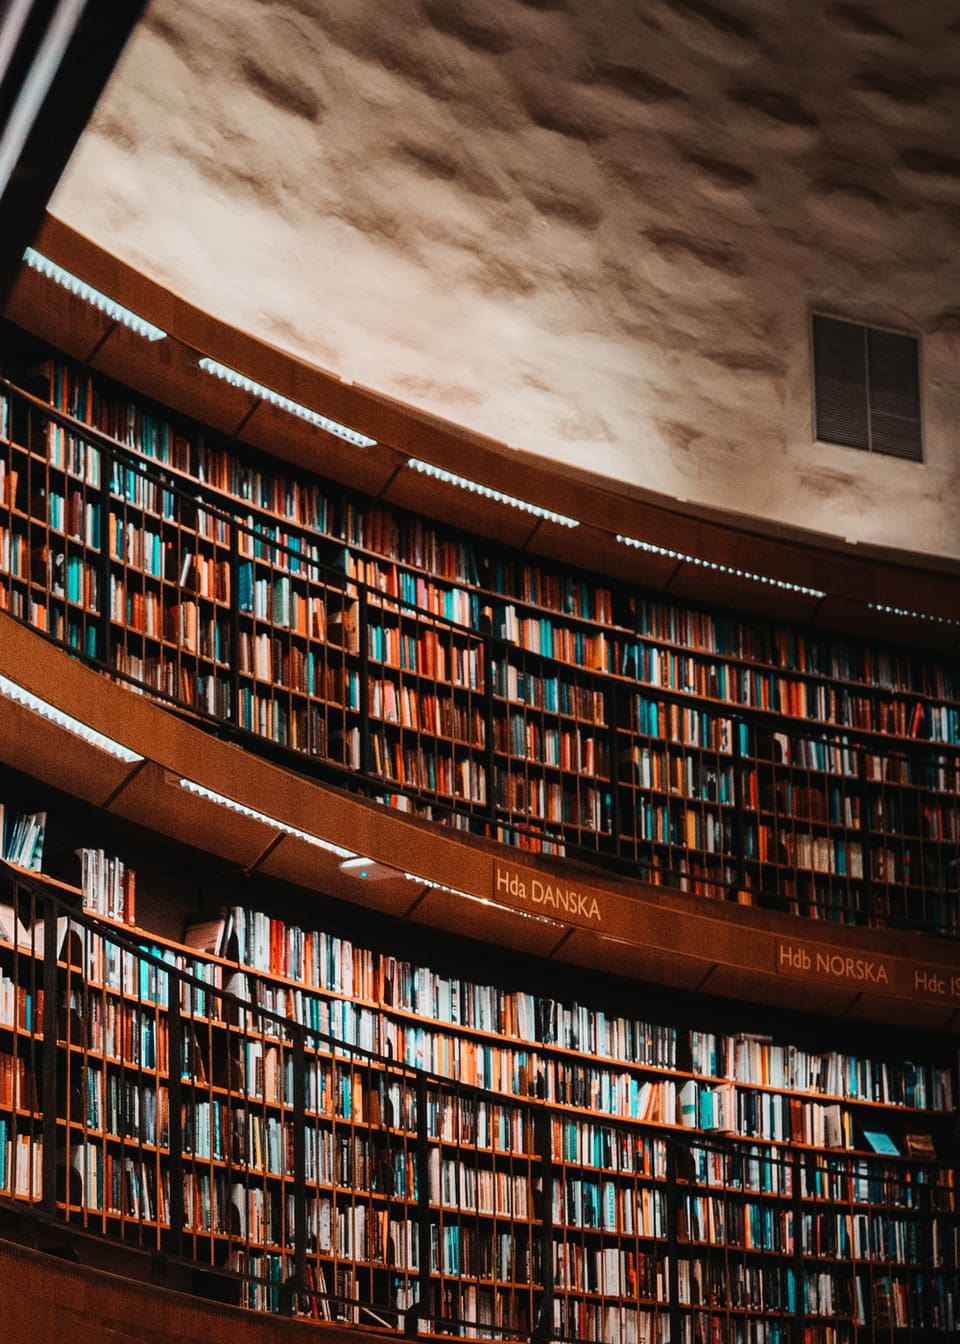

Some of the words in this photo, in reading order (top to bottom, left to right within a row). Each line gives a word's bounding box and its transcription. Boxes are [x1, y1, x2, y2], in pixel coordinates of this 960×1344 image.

[497, 868, 526, 898] Hda
[531, 879, 602, 921] DANSKA
[779, 944, 811, 970] Hdb
[816, 952, 889, 984] NORSKA
[914, 970, 945, 994] Hdc
